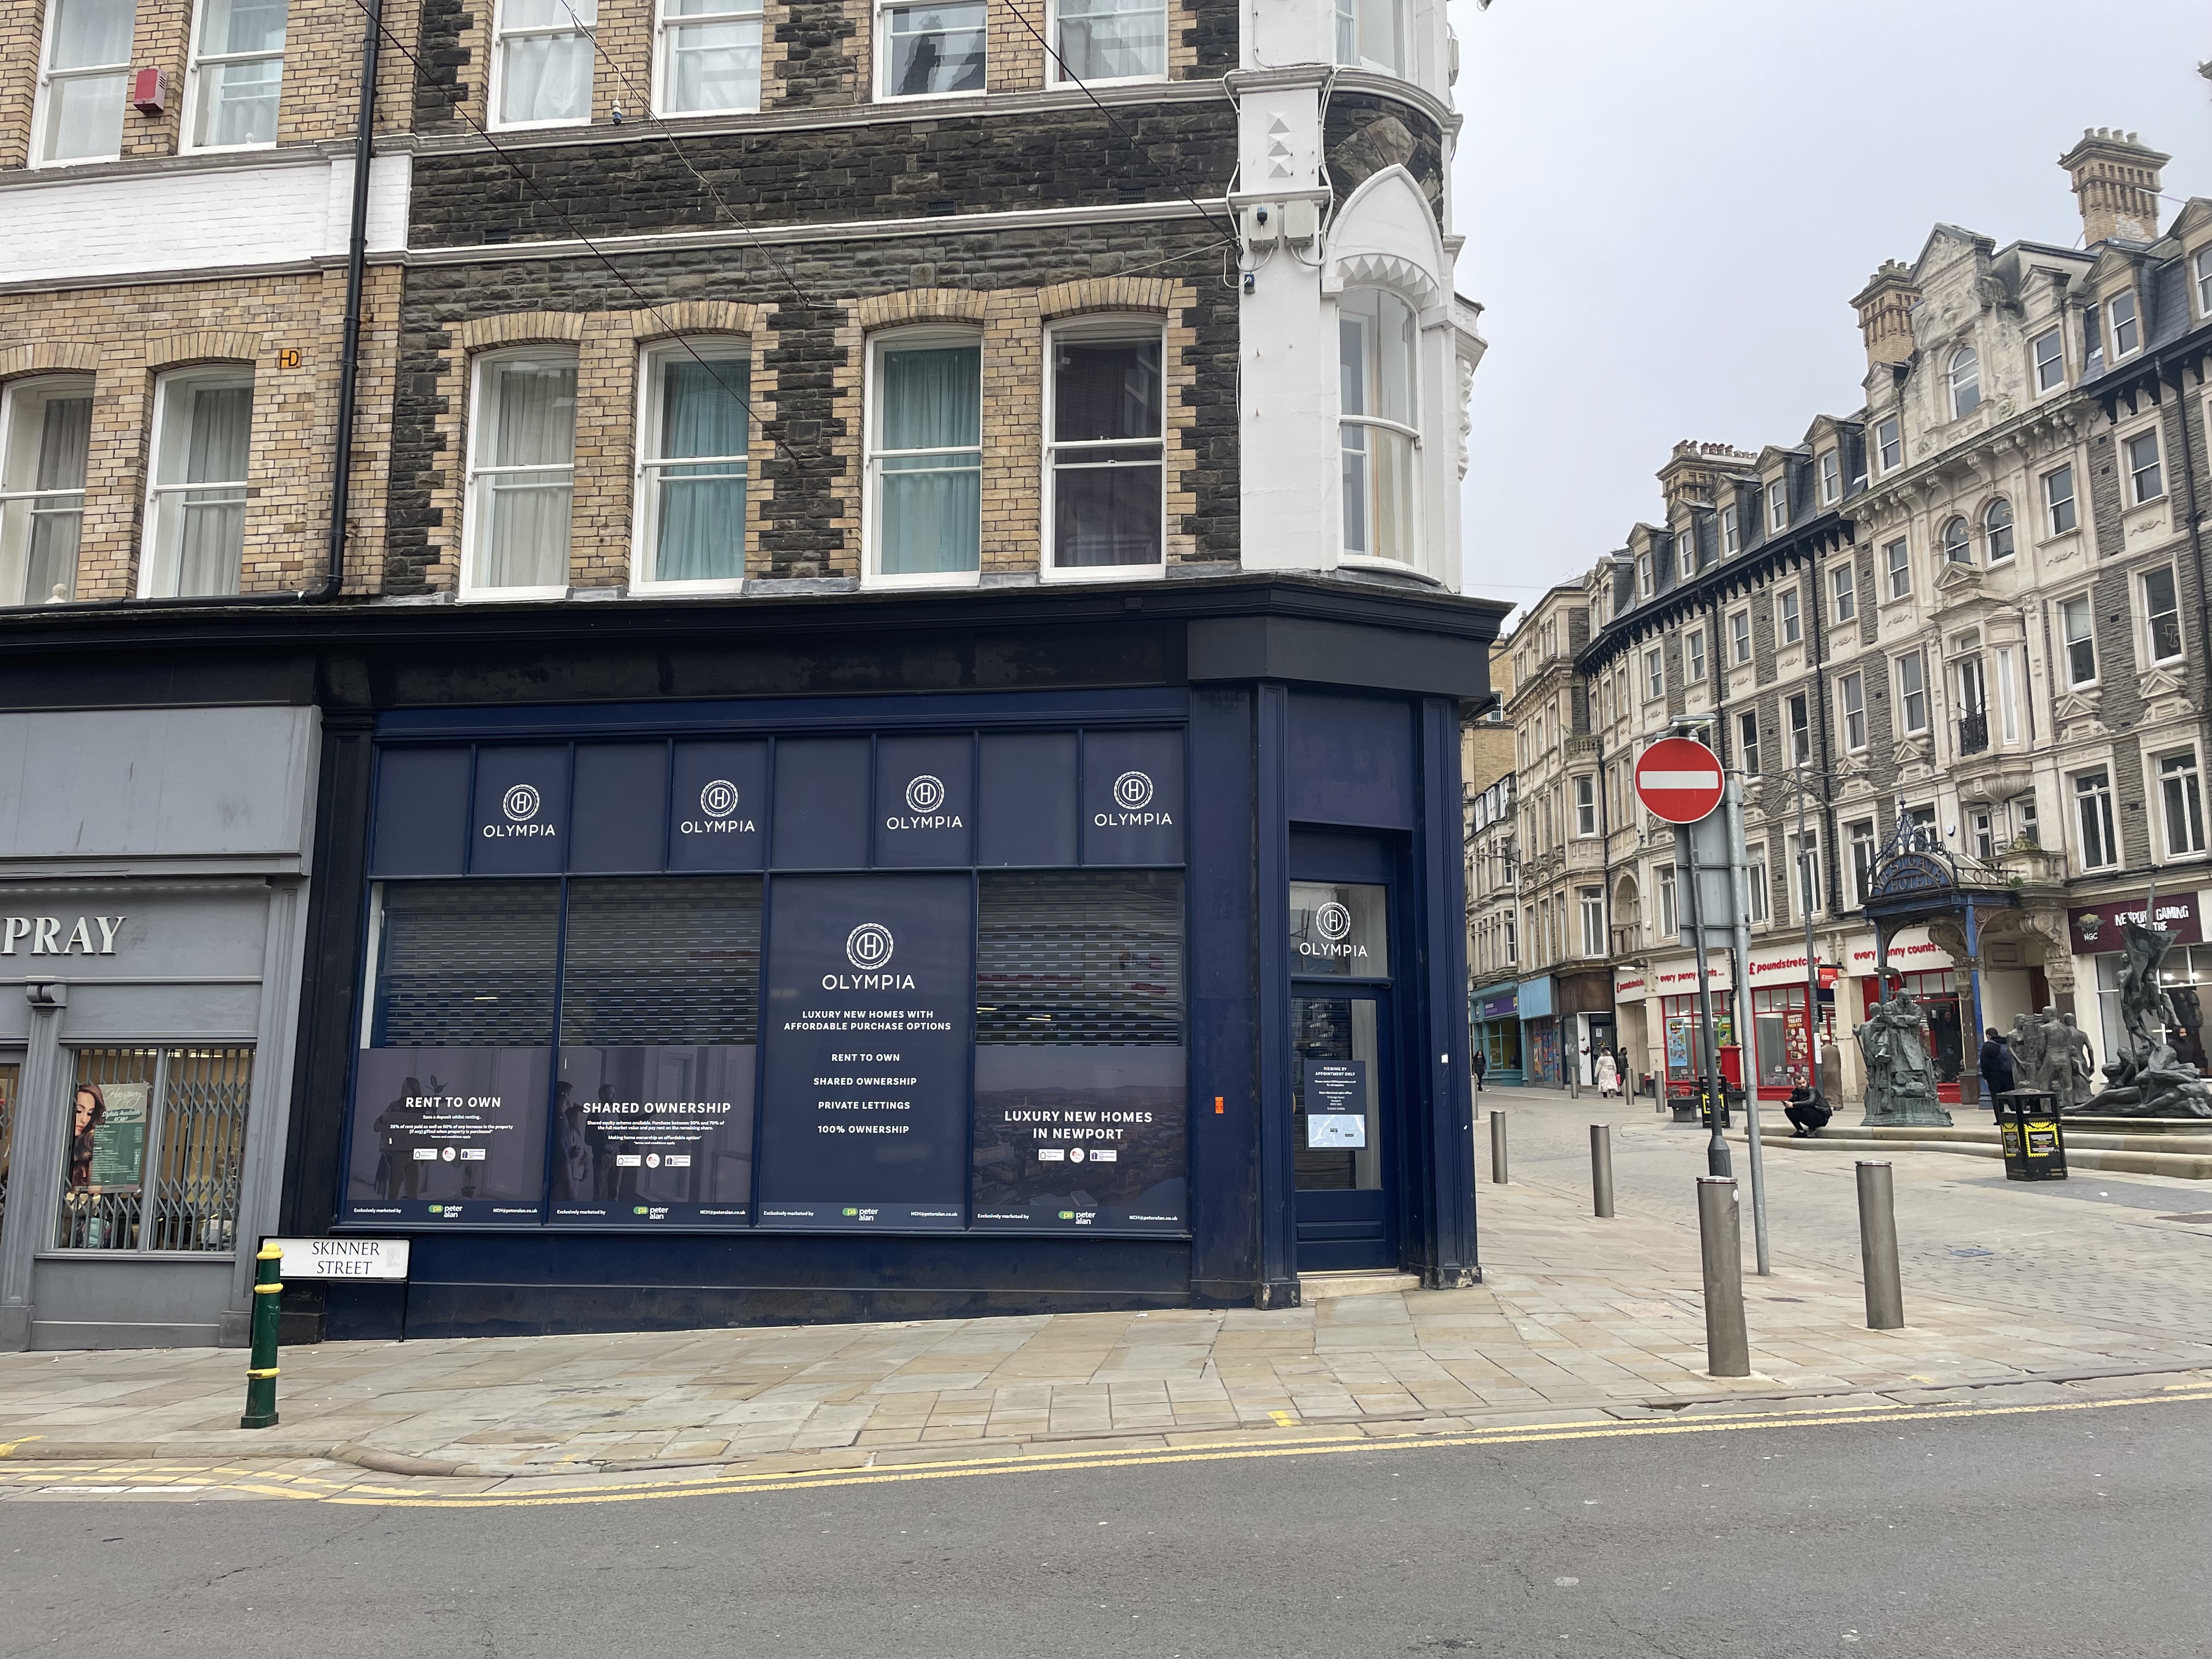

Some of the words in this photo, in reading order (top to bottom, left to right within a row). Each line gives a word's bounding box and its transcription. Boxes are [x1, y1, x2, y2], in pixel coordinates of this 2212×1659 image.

[887, 816, 962, 830] OLYMPIA
[1094, 812, 1172, 826] OLYMPIA
[483, 825, 555, 837] OLYMPIA
[681, 820, 755, 833] OLYMPIA
[1891, 873, 1932, 891] HOTEL
[2156, 905, 2189, 921] GAMING
[0, 916, 127, 955] PRAY
[2084, 933, 2098, 941] NGC
[1299, 943, 1368, 957] OLYMPIA
[1854, 951, 1876, 960] every
[1908, 943, 1936, 954] counts
[1750, 962, 1755, 975] £
[1757, 956, 1821, 974] poundstretcer
[822, 974, 915, 990] OLYMPIA
[1660, 974, 1676, 983] every
[1678, 972, 1696, 983] penny
[802, 1011, 841, 1019] LUXURY
[844, 1011, 866, 1019] NEW
[869, 1011, 904, 1019] HOMES
[907, 1011, 934, 1019] WITH
[784, 1022, 848, 1030] AFFORDABLE
[850, 1022, 904, 1030] PURCHASE
[906, 1022, 951, 1030] OPTIONS
[813, 1077, 853, 1086] SHARED
[856, 1077, 917, 1086] OWNERSHIP
[405, 1097, 442, 1108] RENT
[445, 1097, 463, 1108] TO
[467, 1097, 501, 1108] OWN
[583, 1102, 639, 1113] SHARED
[644, 1102, 731, 1113] OWNERSHIP
[818, 1101, 859, 1109] PRIVATE
[862, 1101, 910, 1109] LETTINGS
[1005, 1110, 1060, 1121] LUXURY
[1064, 1111, 1097, 1122] NEW
[1101, 1111, 1152, 1122] HOMES
[817, 1125, 845, 1133] 100%
[848, 1125, 909, 1133] OWNERSHIP
[1033, 1128, 1047, 1138] IN
[1053, 1128, 1124, 1139] NEWPORT
[1076, 1211, 1096, 1220] peter
[312, 1242, 380, 1255] SKINNER
[317, 1261, 373, 1274] STREET
